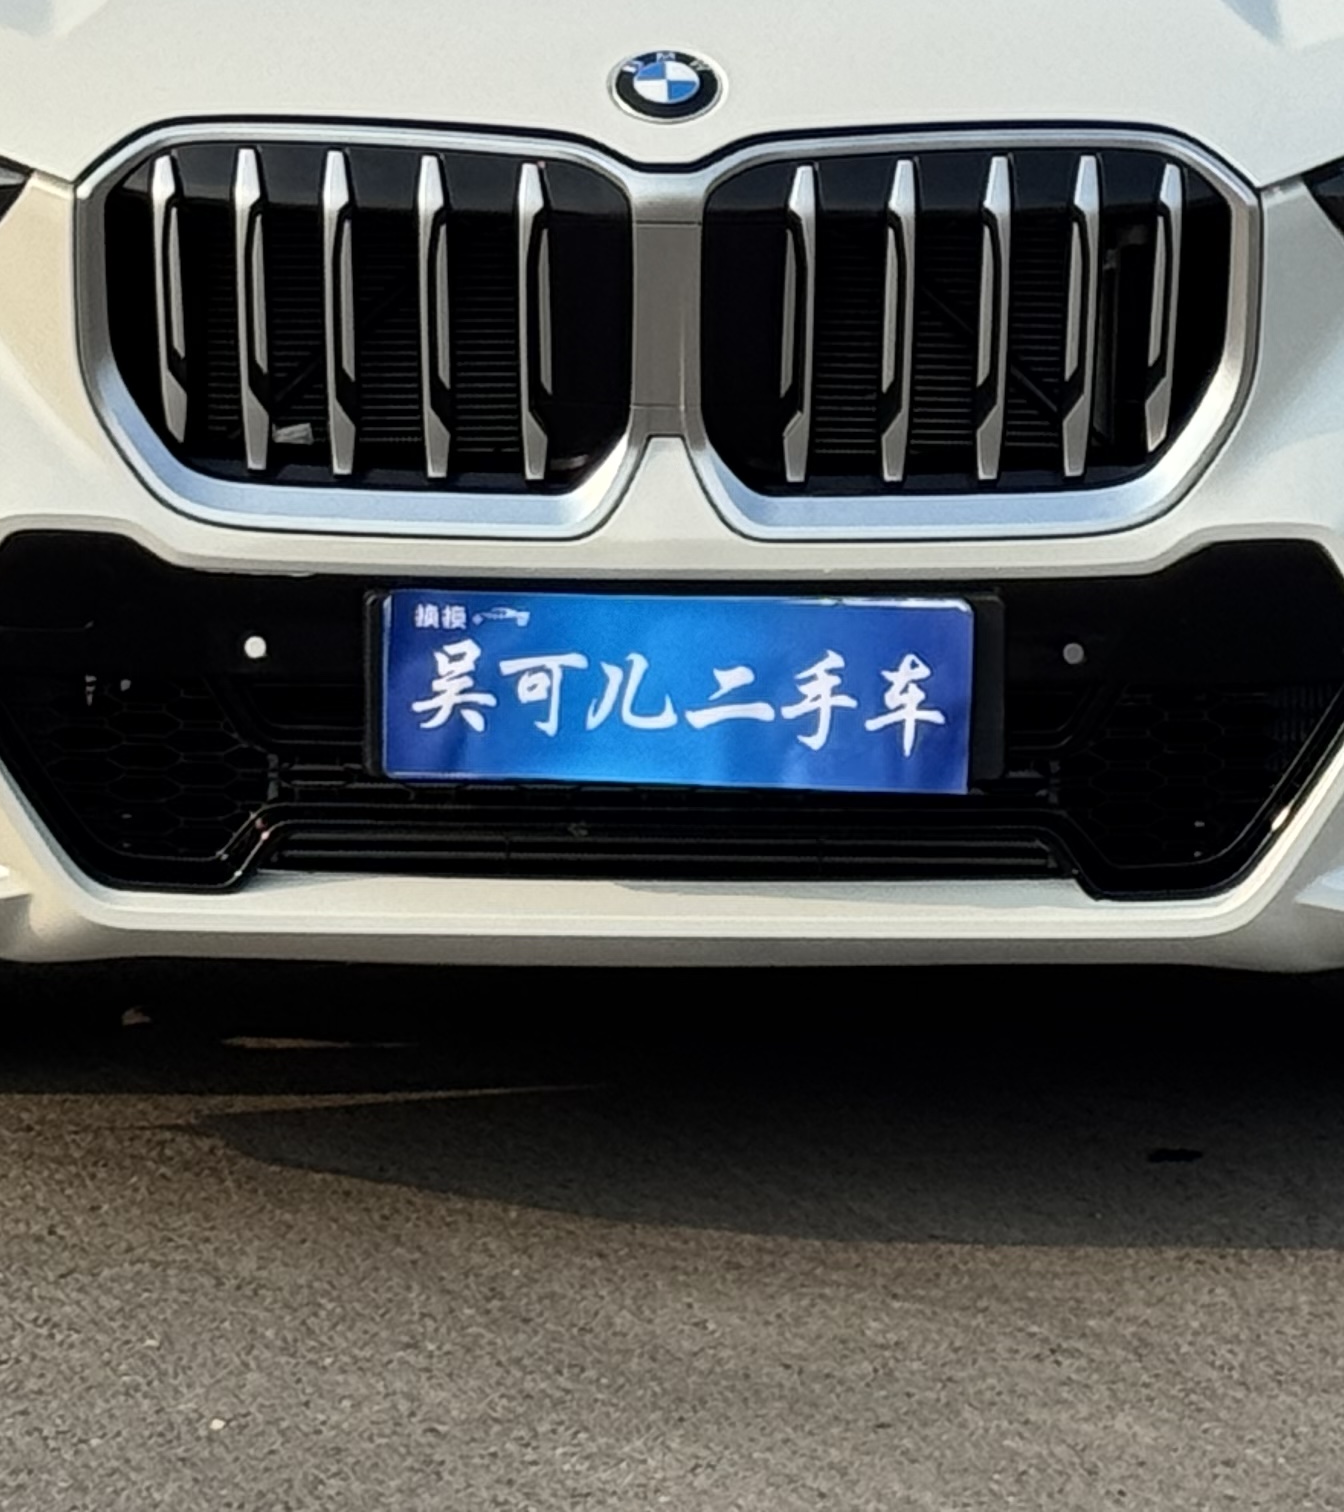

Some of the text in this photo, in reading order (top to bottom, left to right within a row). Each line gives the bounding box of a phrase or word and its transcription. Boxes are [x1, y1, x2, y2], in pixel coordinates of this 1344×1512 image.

[411, 638, 947, 757] 吴可儿二手车
